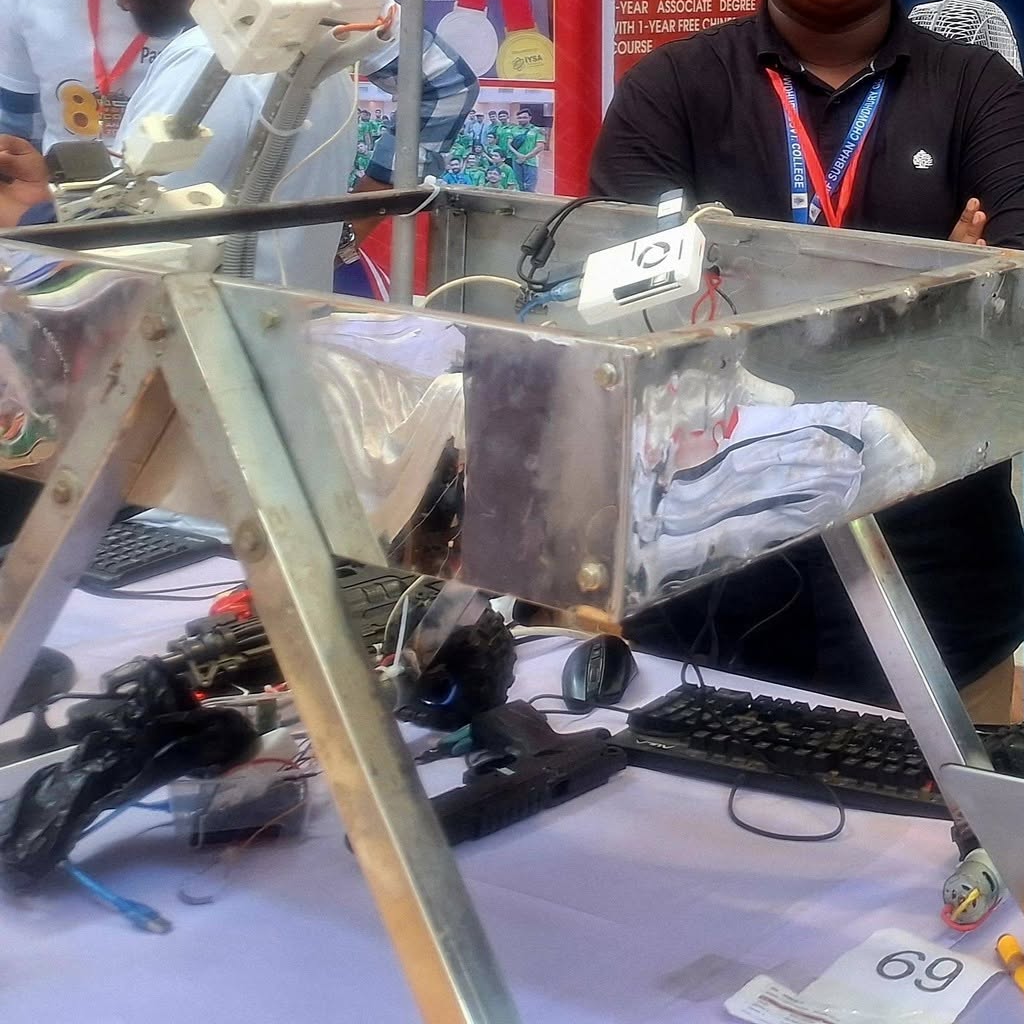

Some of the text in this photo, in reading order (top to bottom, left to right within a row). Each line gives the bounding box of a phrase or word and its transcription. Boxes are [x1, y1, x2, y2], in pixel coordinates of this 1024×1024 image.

[615, 0, 649, 15] -YEAR
[656, 0, 713, 14] ASSOCIATE
[638, 18, 676, 34] 1-YEAR
[677, 17, 700, 32] FREE
[827, 141, 857, 182] SUBHAN
[849, 90, 880, 142] CHOWDHURY
[790, 143, 806, 188] COLLEGE
[876, 950, 964, 993] 69
